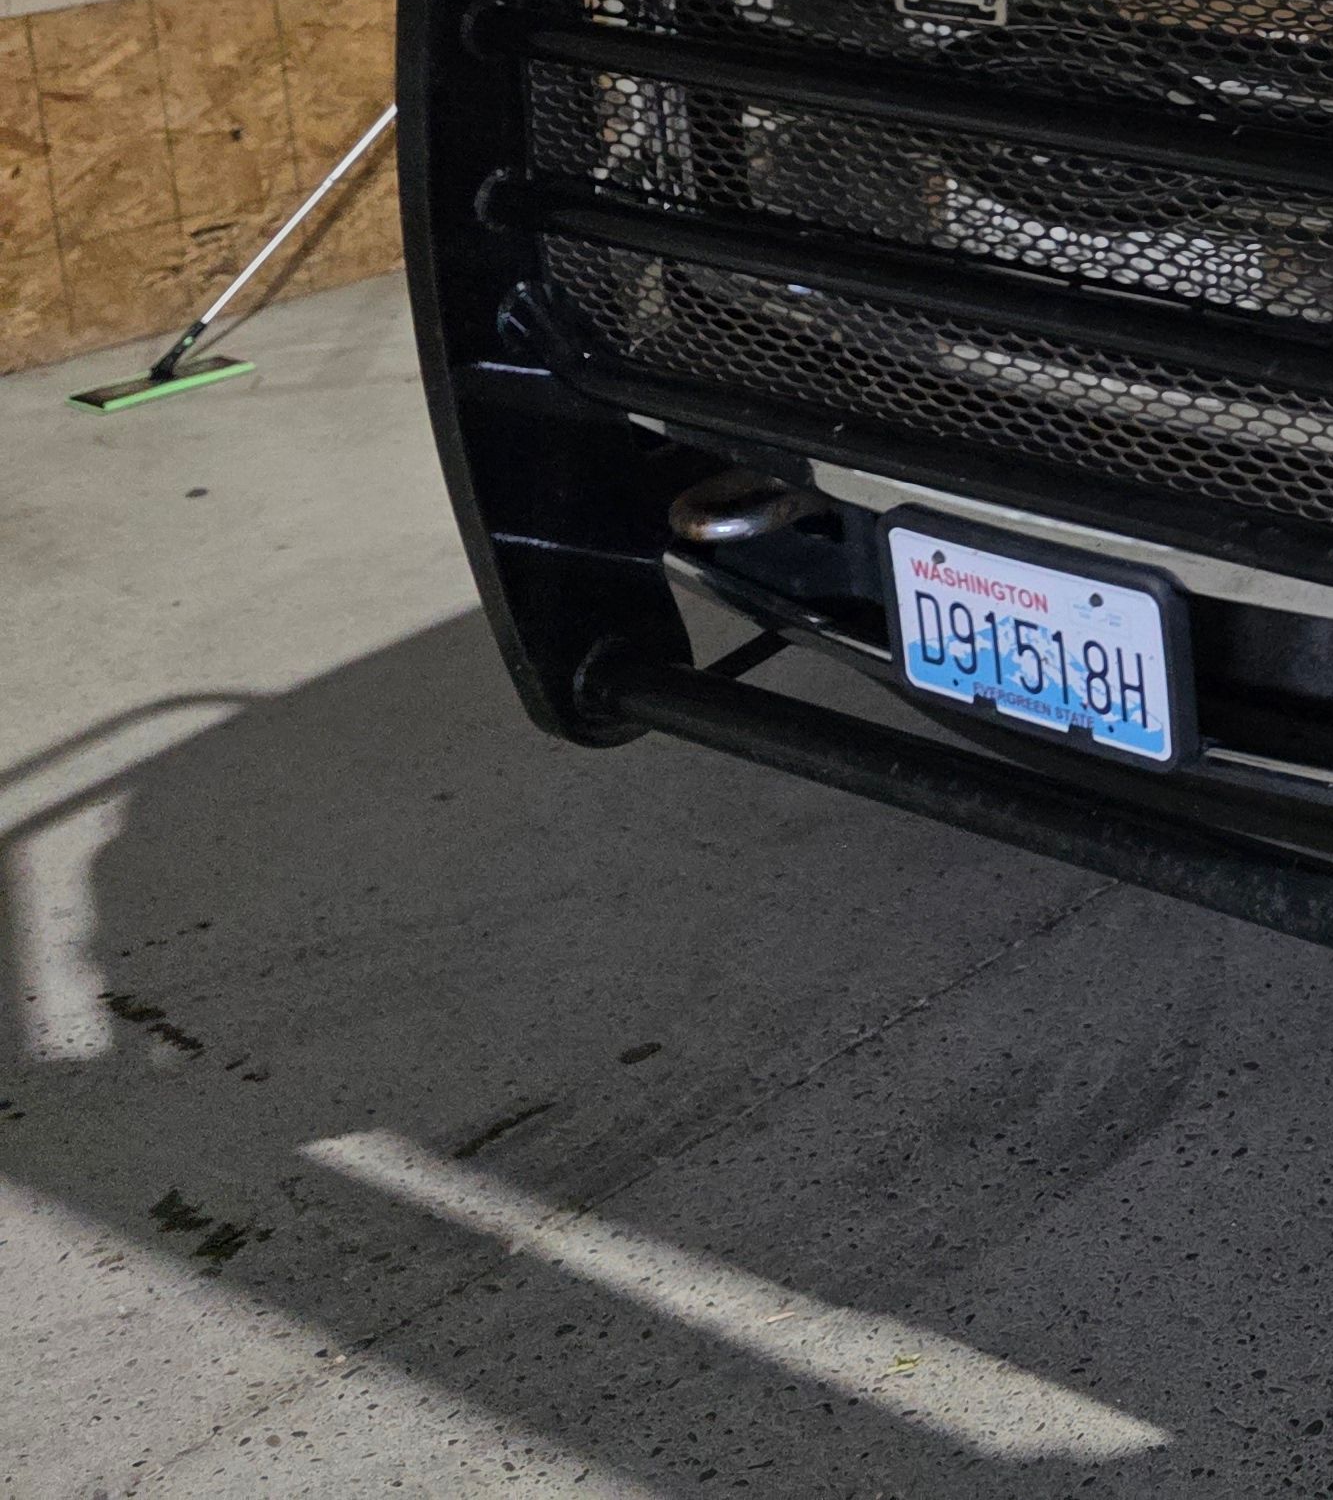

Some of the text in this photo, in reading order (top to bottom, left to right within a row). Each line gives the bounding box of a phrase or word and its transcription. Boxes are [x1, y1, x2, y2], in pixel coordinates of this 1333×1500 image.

[910, 556, 1049, 613] WASHINGTON
[915, 590, 1148, 730] D91518H
[973, 681, 1095, 730] EVERGREEN STATE
